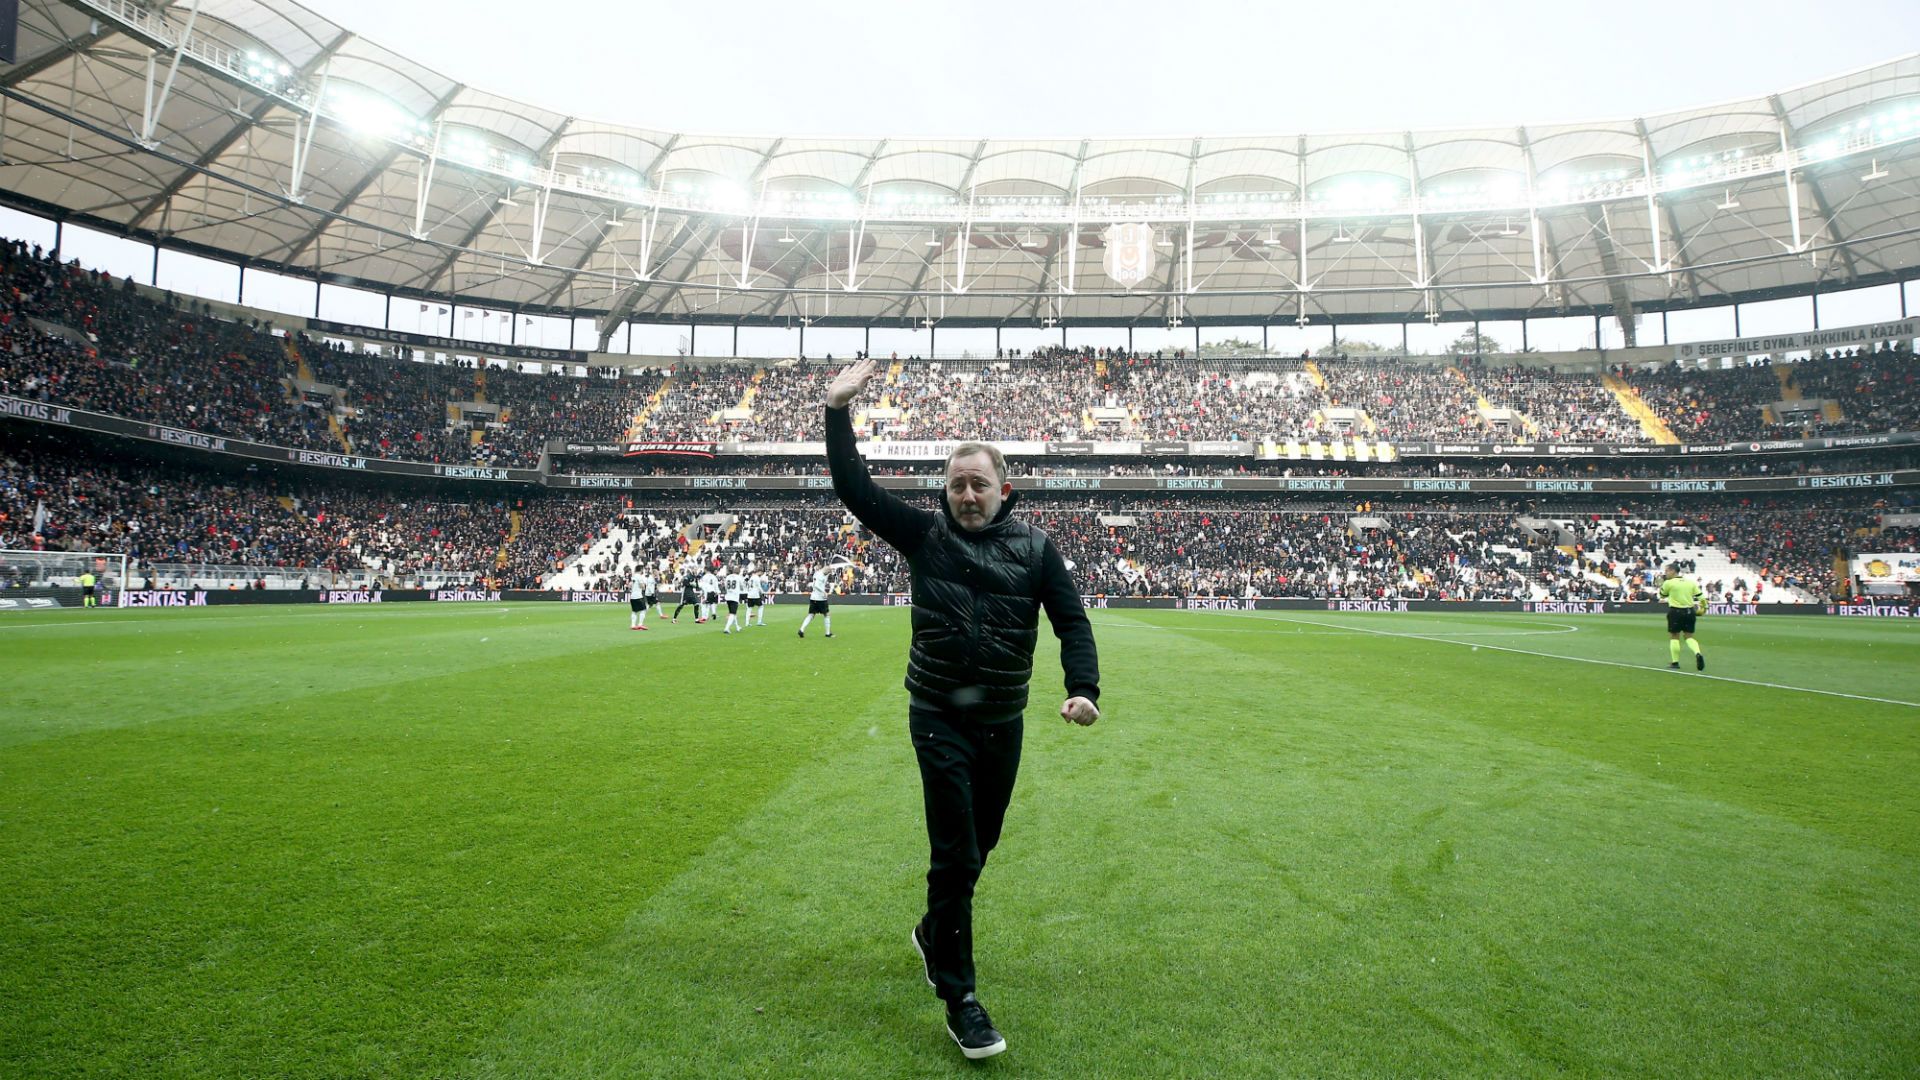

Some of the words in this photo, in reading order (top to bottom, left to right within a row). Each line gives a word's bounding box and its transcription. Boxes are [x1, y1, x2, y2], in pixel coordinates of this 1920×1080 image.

[342, 325, 408, 342] SADECE
[428, 337, 506, 356] BEŞİKTAŞ
[1699, 341, 1760, 357] ŞEREFİNLE
[1803, 330, 1866, 347] HAKKINLA
[1871, 322, 1913, 338] KAZAN
[52, 408, 71, 423] JK
[211, 438, 225, 450] JK
[1762, 441, 1804, 450] vodafone
[888, 445, 929, 456] HAYATTA
[351, 457, 366, 469] JK
[495, 469, 508, 479] JK
[621, 478, 633, 488] JK
[735, 478, 747, 488] JK
[1089, 480, 1101, 489] JK
[1211, 480, 1223, 489] JK
[1875, 474, 1894, 485] JK
[1333, 481, 1345, 490] JK
[1458, 481, 1471, 491] JK
[1580, 481, 1593, 491] JK
[1711, 480, 1726, 491] JK
[189, 591, 207, 607] JK
[371, 591, 382, 602] JK
[486, 591, 502, 601] JK
[1094, 599, 1108, 609] JK
[1241, 600, 1256, 610] JK
[1394, 602, 1408, 612] JK
[1589, 604, 1604, 614] JK
[1742, 604, 1757, 615] JK
